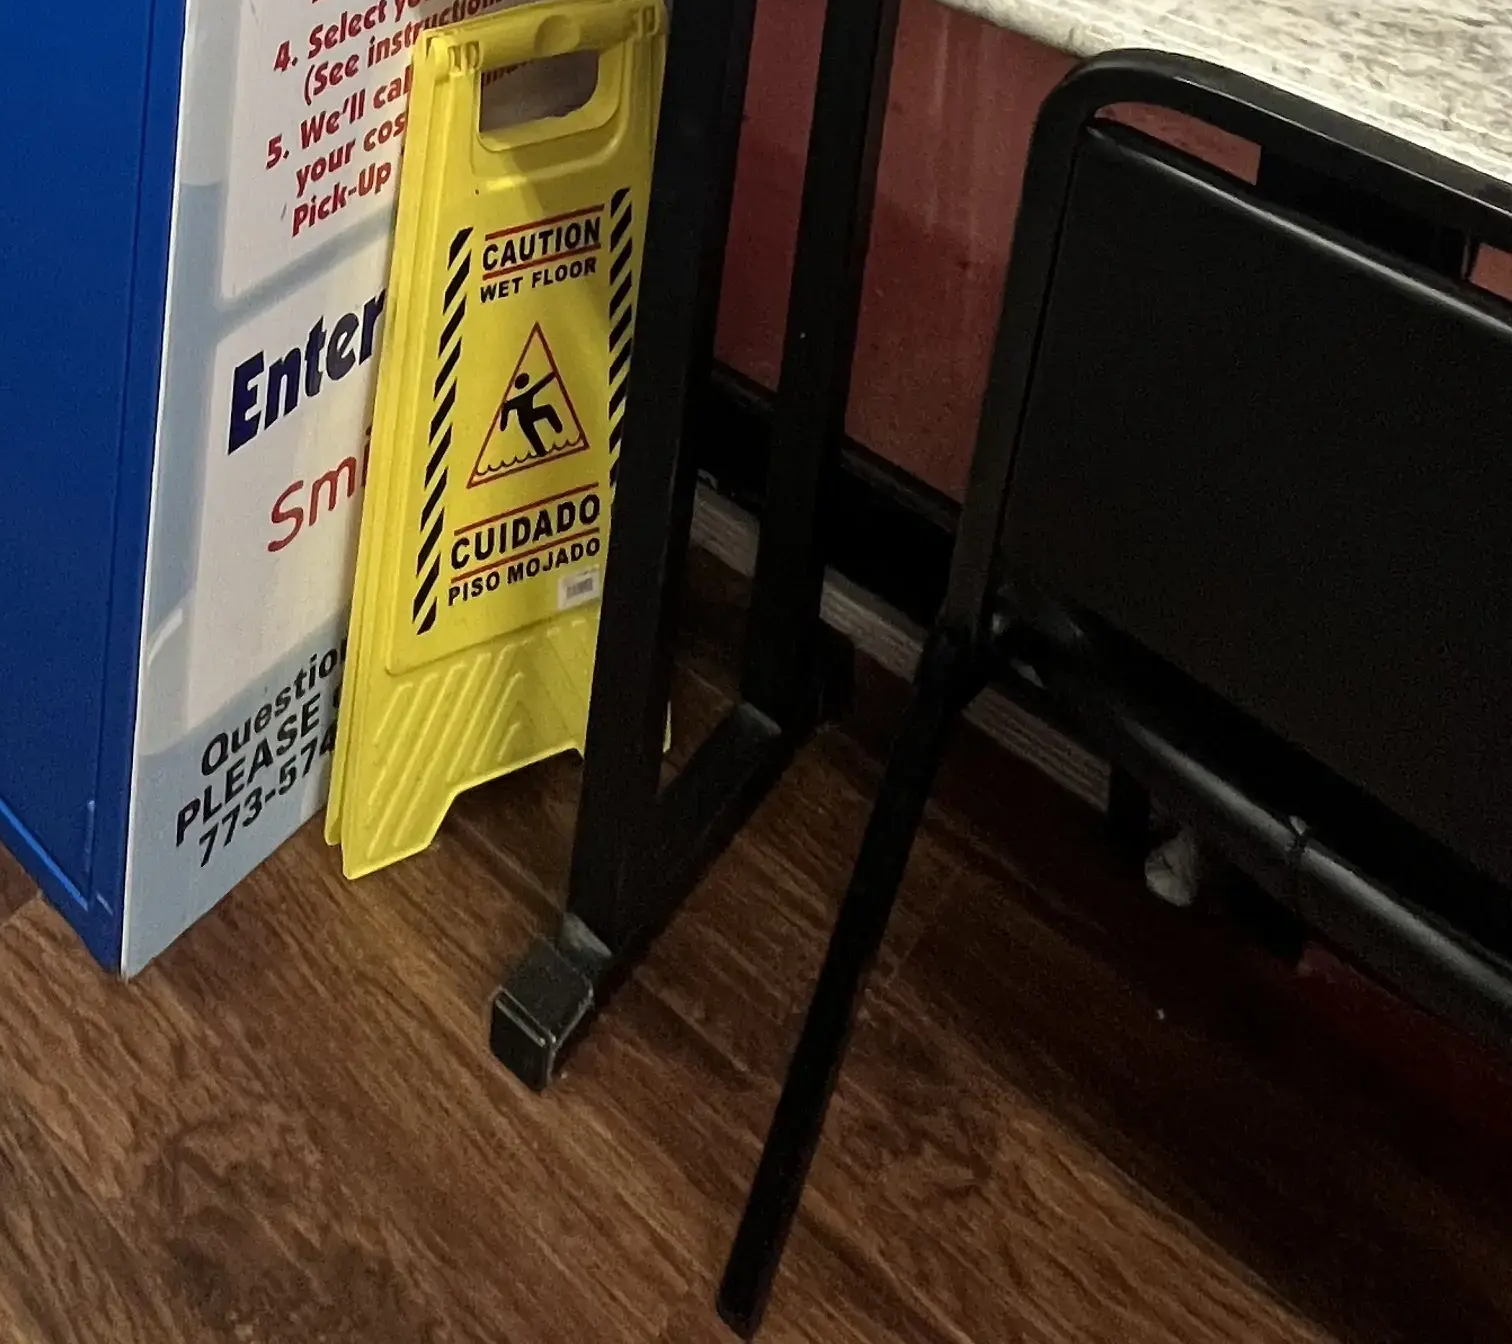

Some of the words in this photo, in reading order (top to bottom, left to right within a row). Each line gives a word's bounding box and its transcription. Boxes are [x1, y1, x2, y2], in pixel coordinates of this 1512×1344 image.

[273, 40, 298, 73] 4.
[304, 54, 360, 106] (See
[266, 133, 290, 170] 5.
[300, 88, 366, 150] We'll
[373, 64, 413, 109] cal
[296, 138, 356, 198] your
[363, 111, 407, 152] cos
[292, 162, 392, 238] Pick-Up
[480, 276, 523, 304] WET
[532, 256, 597, 290] FLOOR
[482, 217, 602, 273] CAUTION
[227, 288, 387, 455] Enter
[451, 493, 601, 570] CUIDADO
[448, 570, 501, 607] PISO
[507, 537, 601, 586] MOJADO
[176, 693, 321, 848] PLEASE
